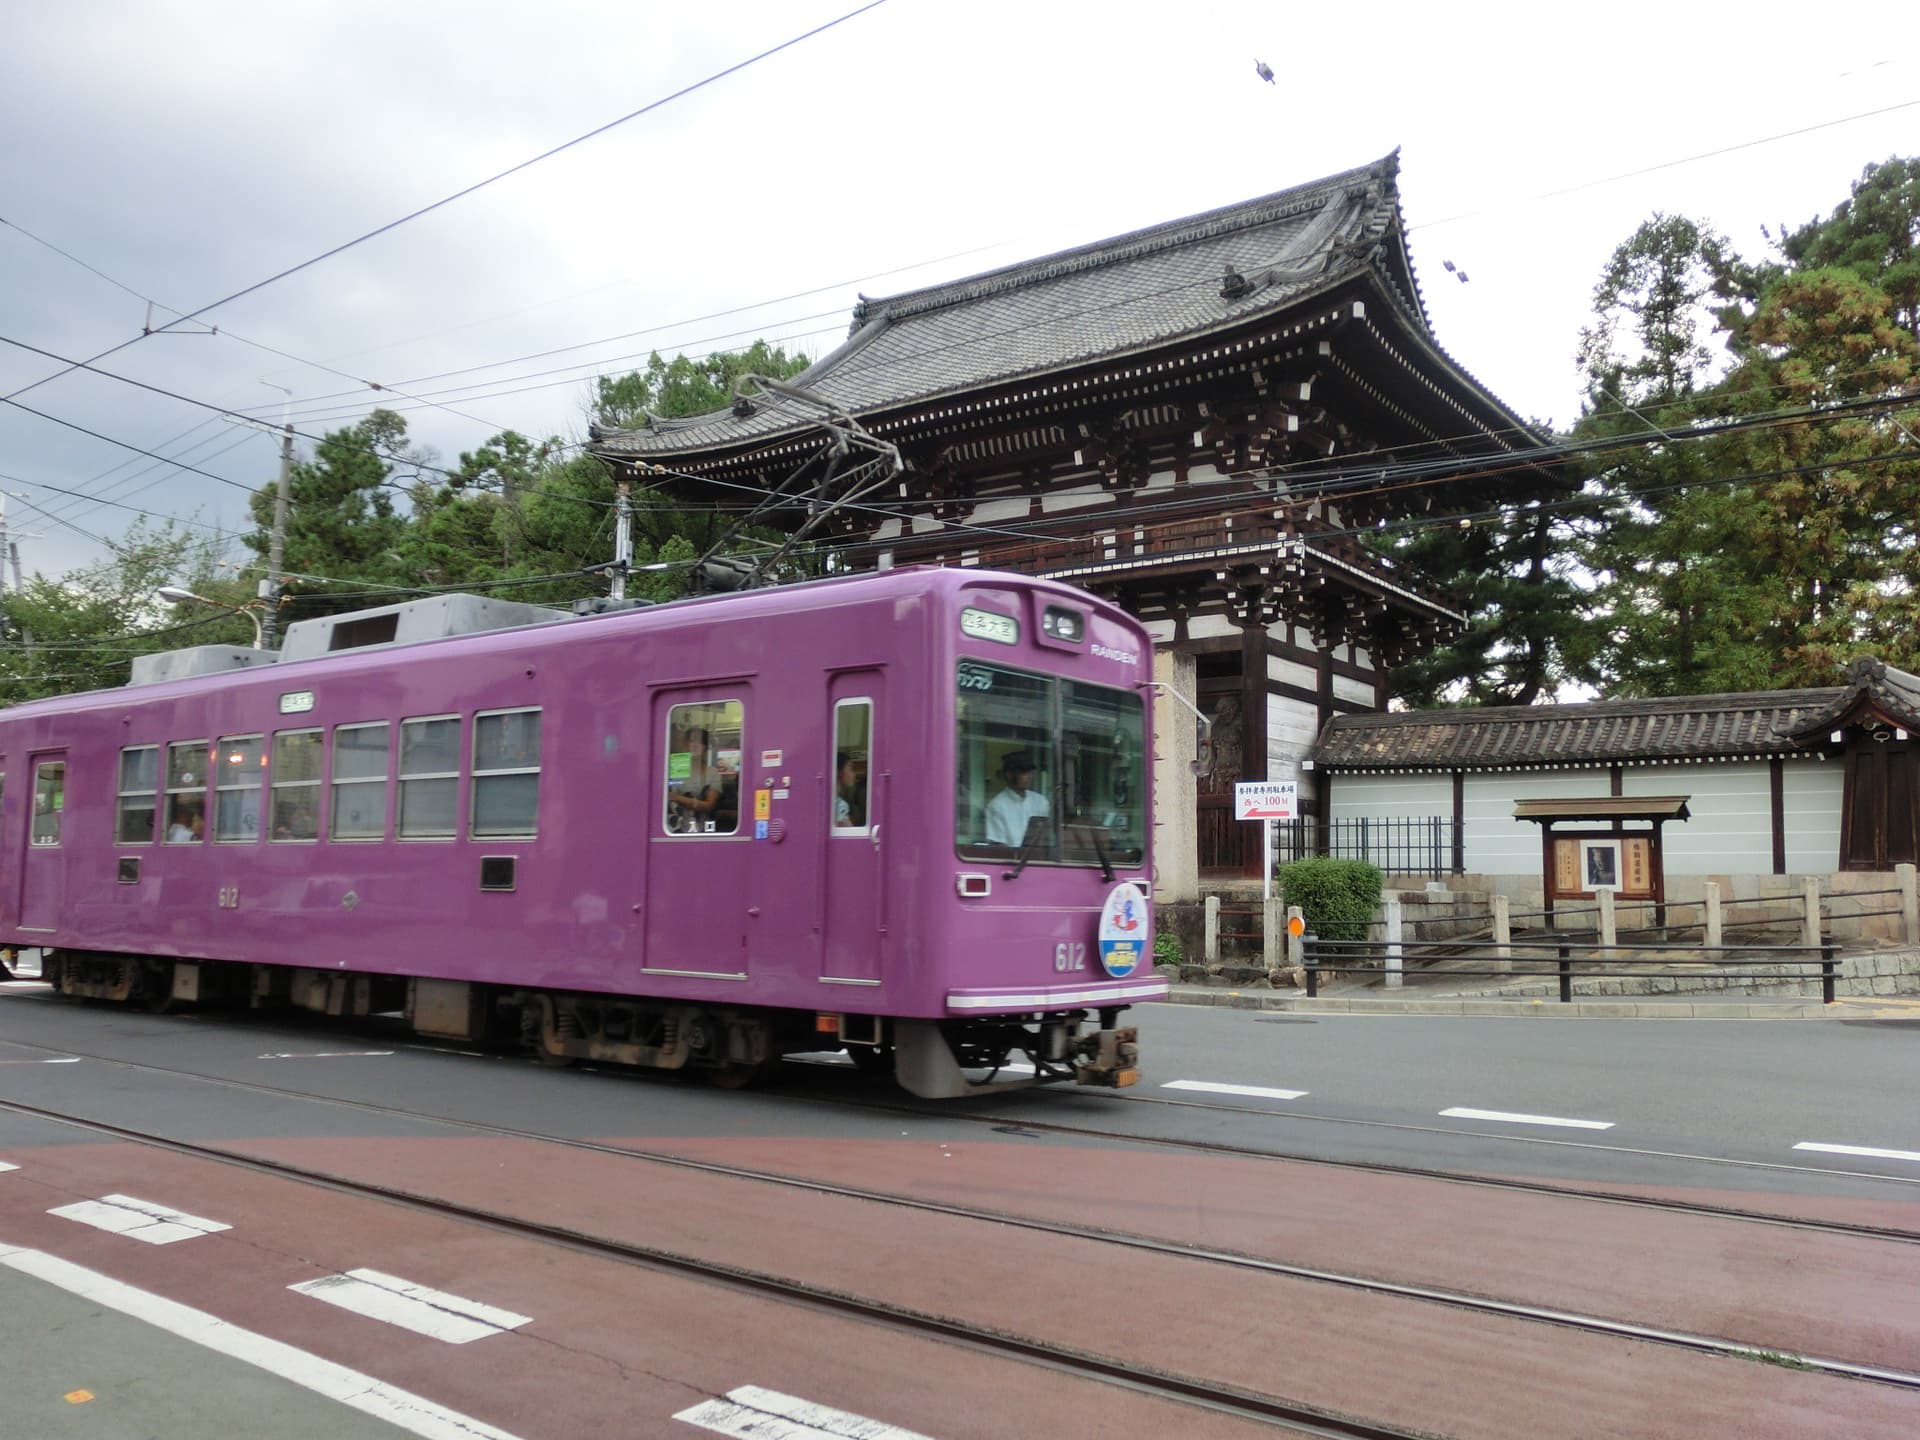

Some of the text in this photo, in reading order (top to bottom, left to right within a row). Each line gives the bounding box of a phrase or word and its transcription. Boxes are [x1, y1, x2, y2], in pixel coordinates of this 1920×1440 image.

[1090, 644, 1138, 665] RANDEN
[218, 887, 240, 909] 612
[1055, 943, 1086, 972] 612
